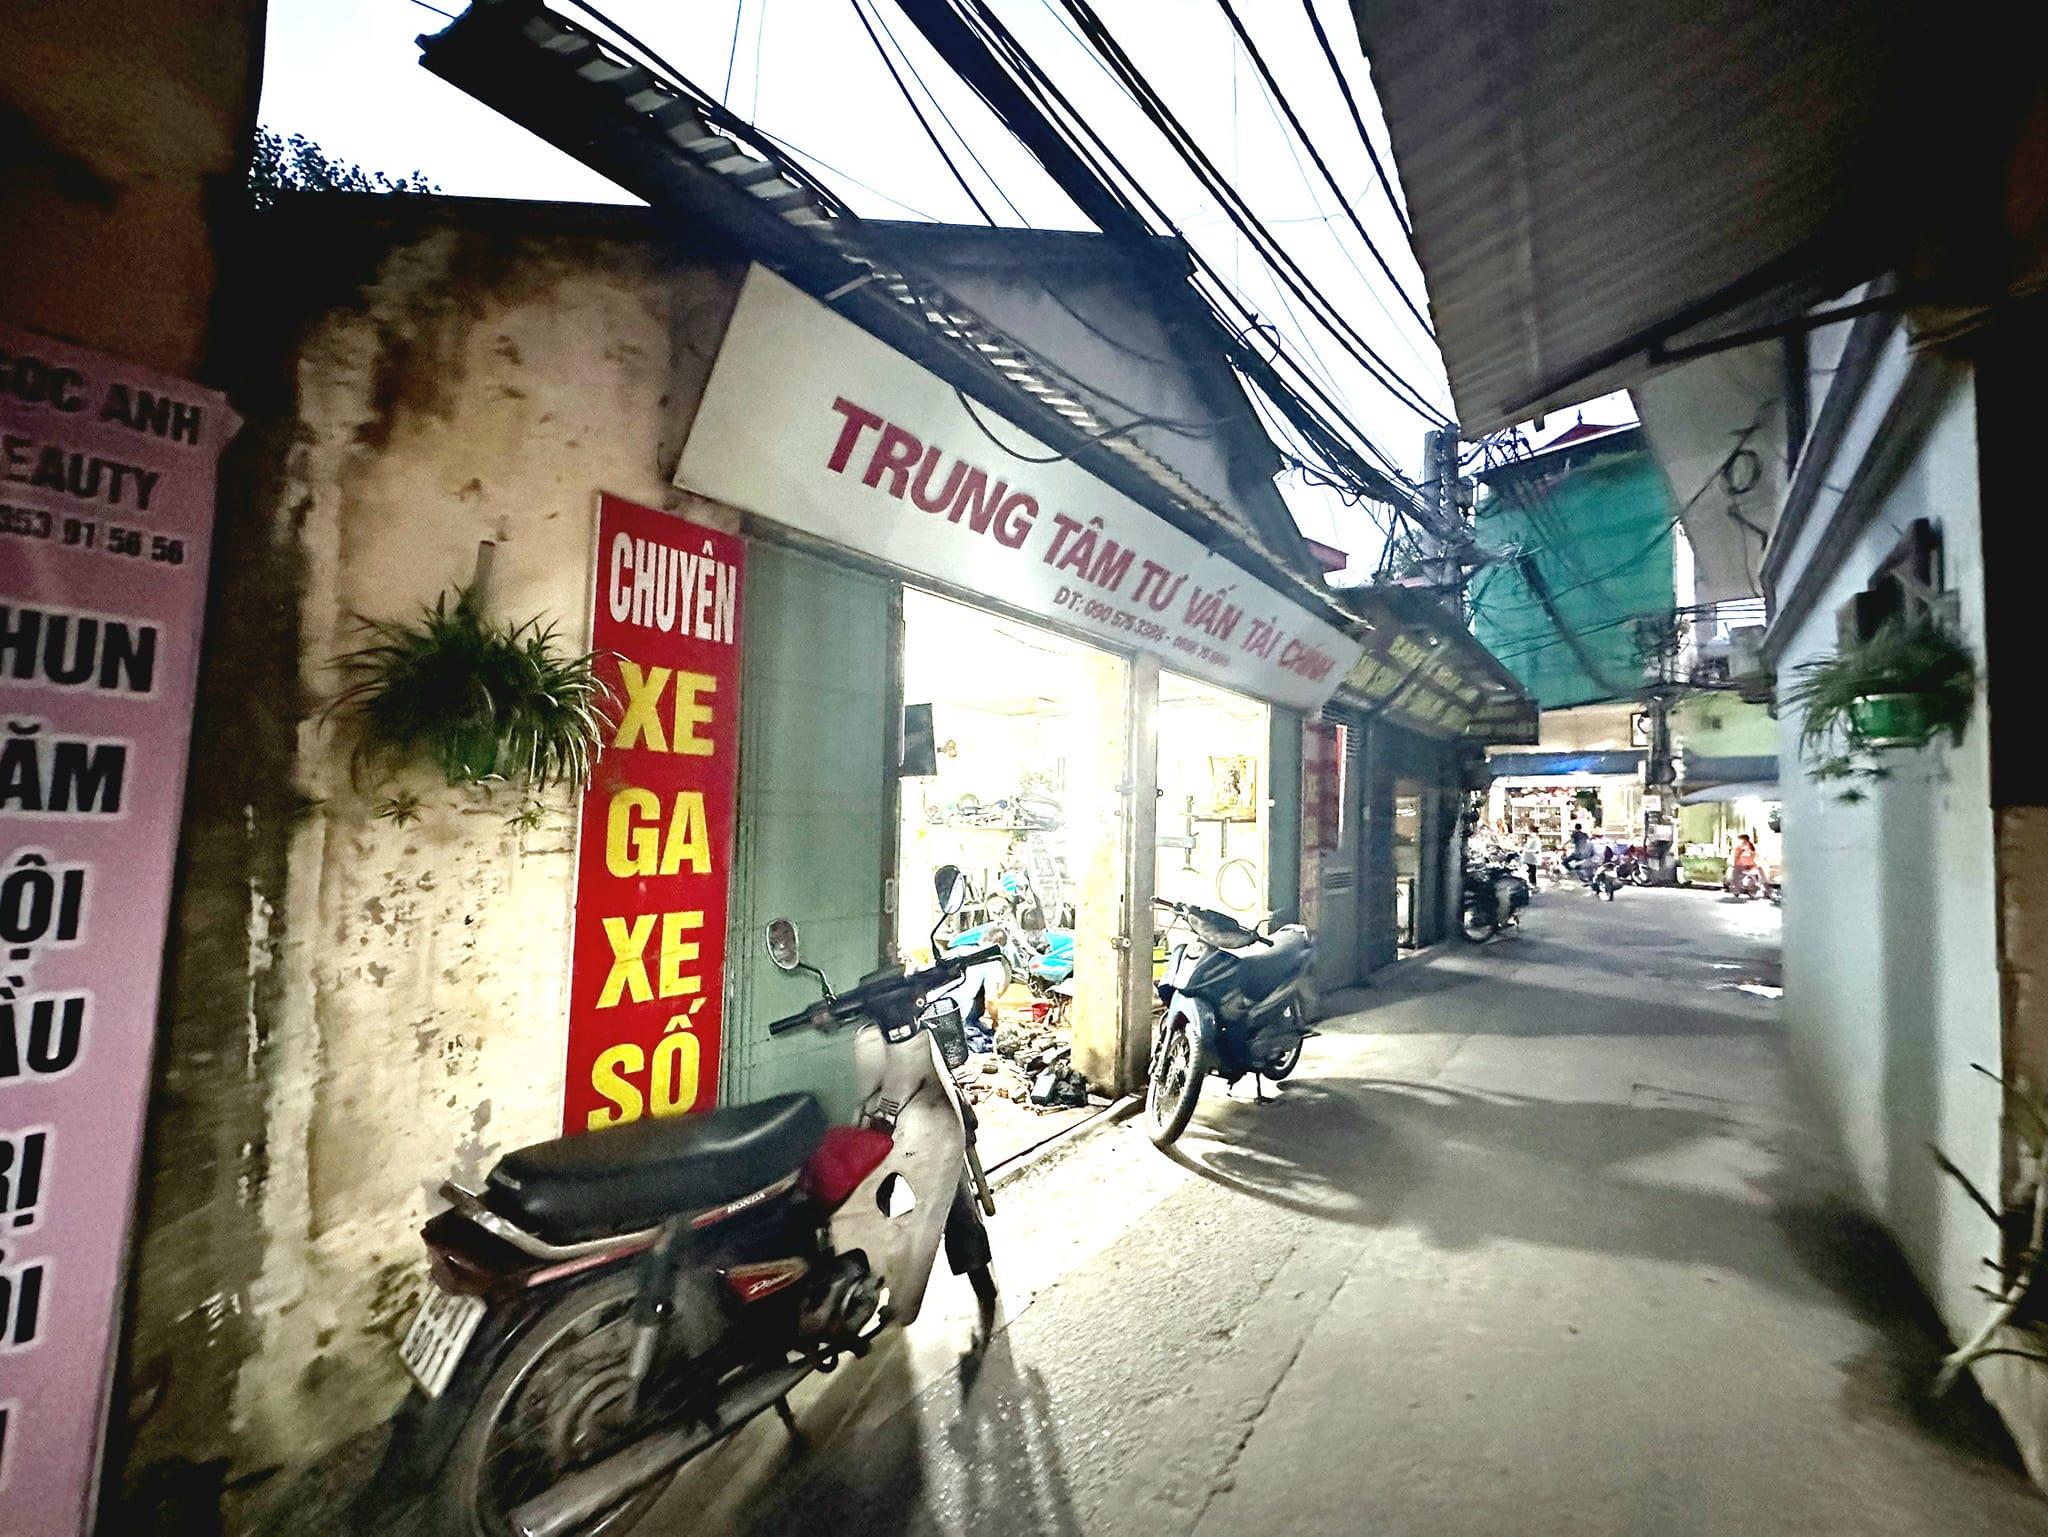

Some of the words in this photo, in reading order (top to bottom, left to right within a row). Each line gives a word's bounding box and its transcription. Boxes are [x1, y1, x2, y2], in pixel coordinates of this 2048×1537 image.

[101, 384, 201, 446] ANH
[2, 435, 160, 511] EAUTY
[827, 396, 1039, 550] TRUNG
[1044, 512, 1136, 592] TÂM
[1131, 560, 1190, 612] TƯ
[1182, 584, 1244, 641] VẤN
[609, 532, 737, 645] CHUYÊN
[613, 660, 717, 757] XE
[0, 721, 127, 813] ĂM
[606, 787, 712, 878] GA
[0, 853, 85, 961] ỘI
[595, 911, 705, 1009] XE
[587, 997, 708, 1132] SỐ
